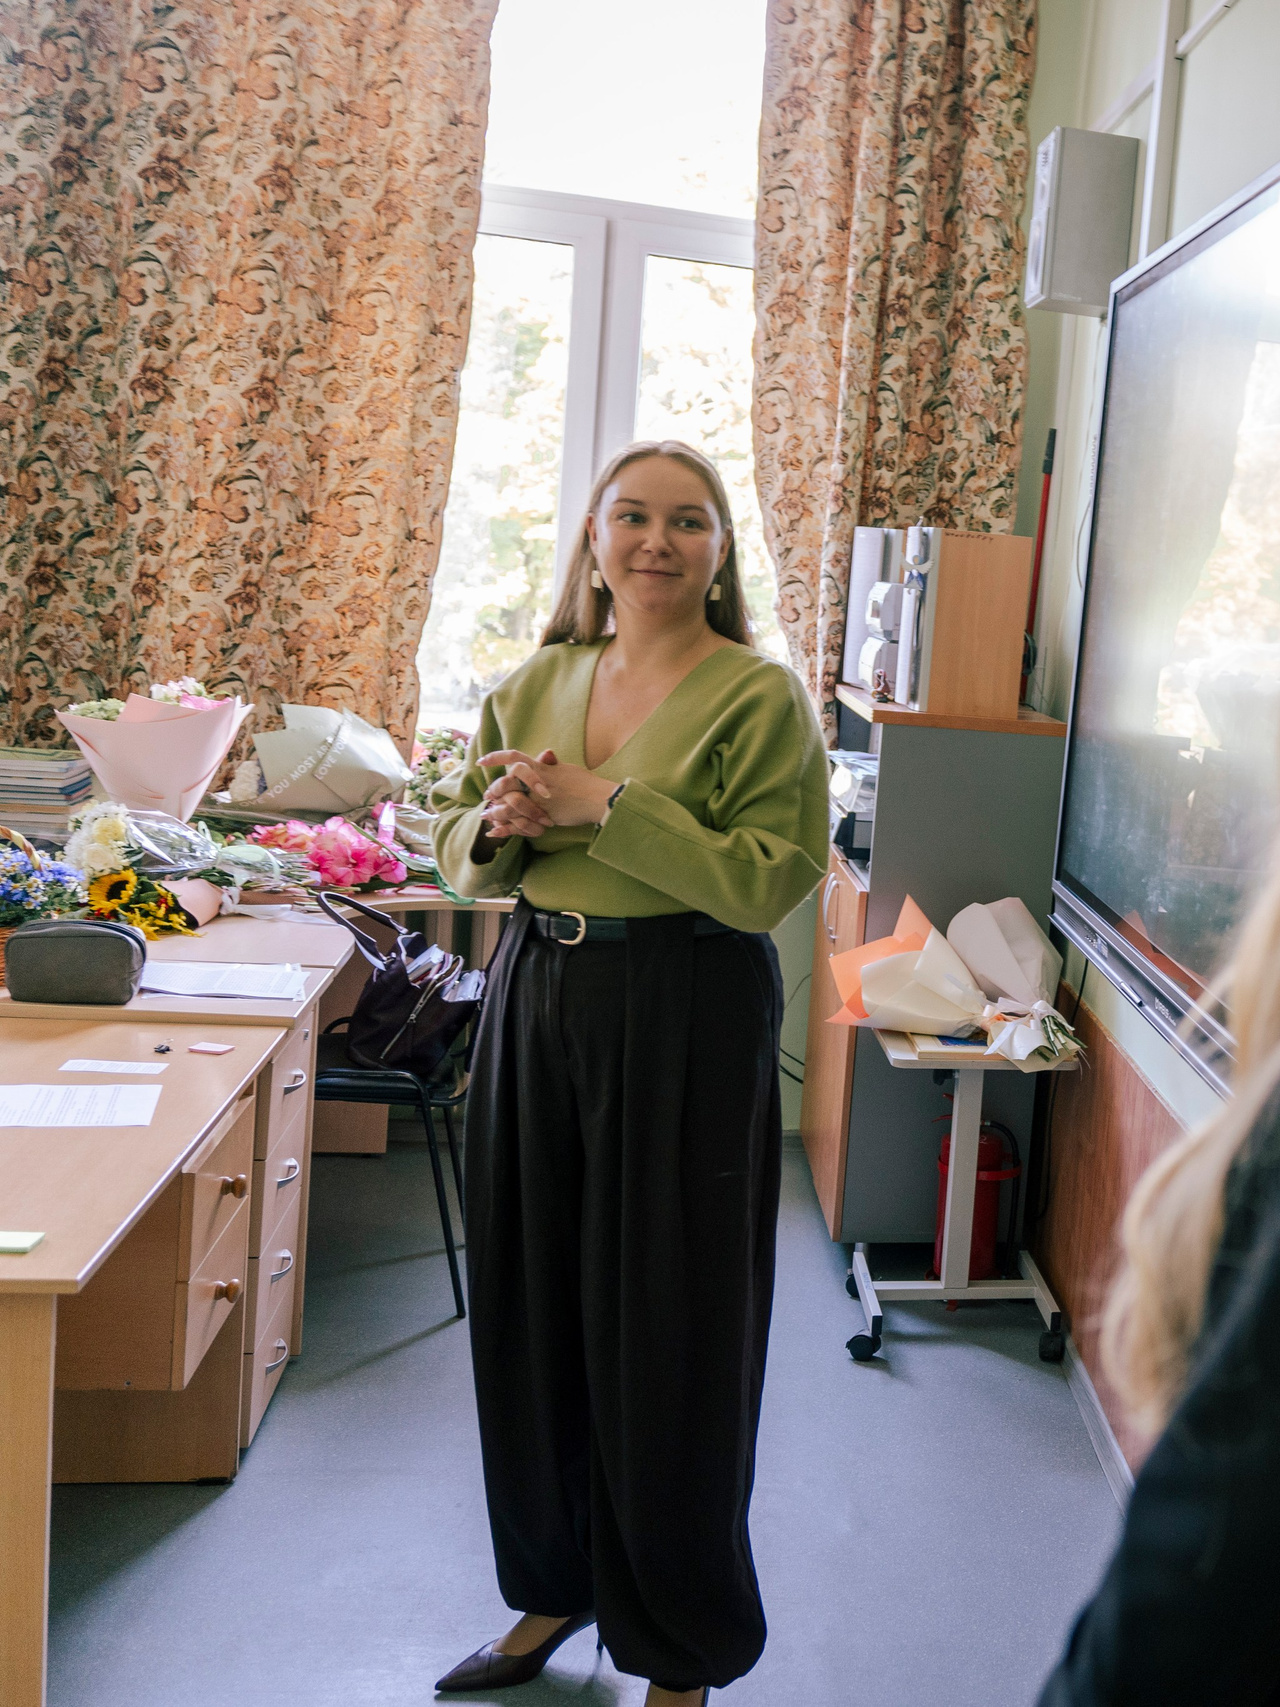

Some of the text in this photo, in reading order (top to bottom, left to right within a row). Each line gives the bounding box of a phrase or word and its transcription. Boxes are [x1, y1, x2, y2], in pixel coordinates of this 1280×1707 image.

[267, 779, 290, 798] YOU
[289, 756, 316, 781] MOST
[314, 756, 337, 780] LOVE
[332, 736, 347, 754] YOU
